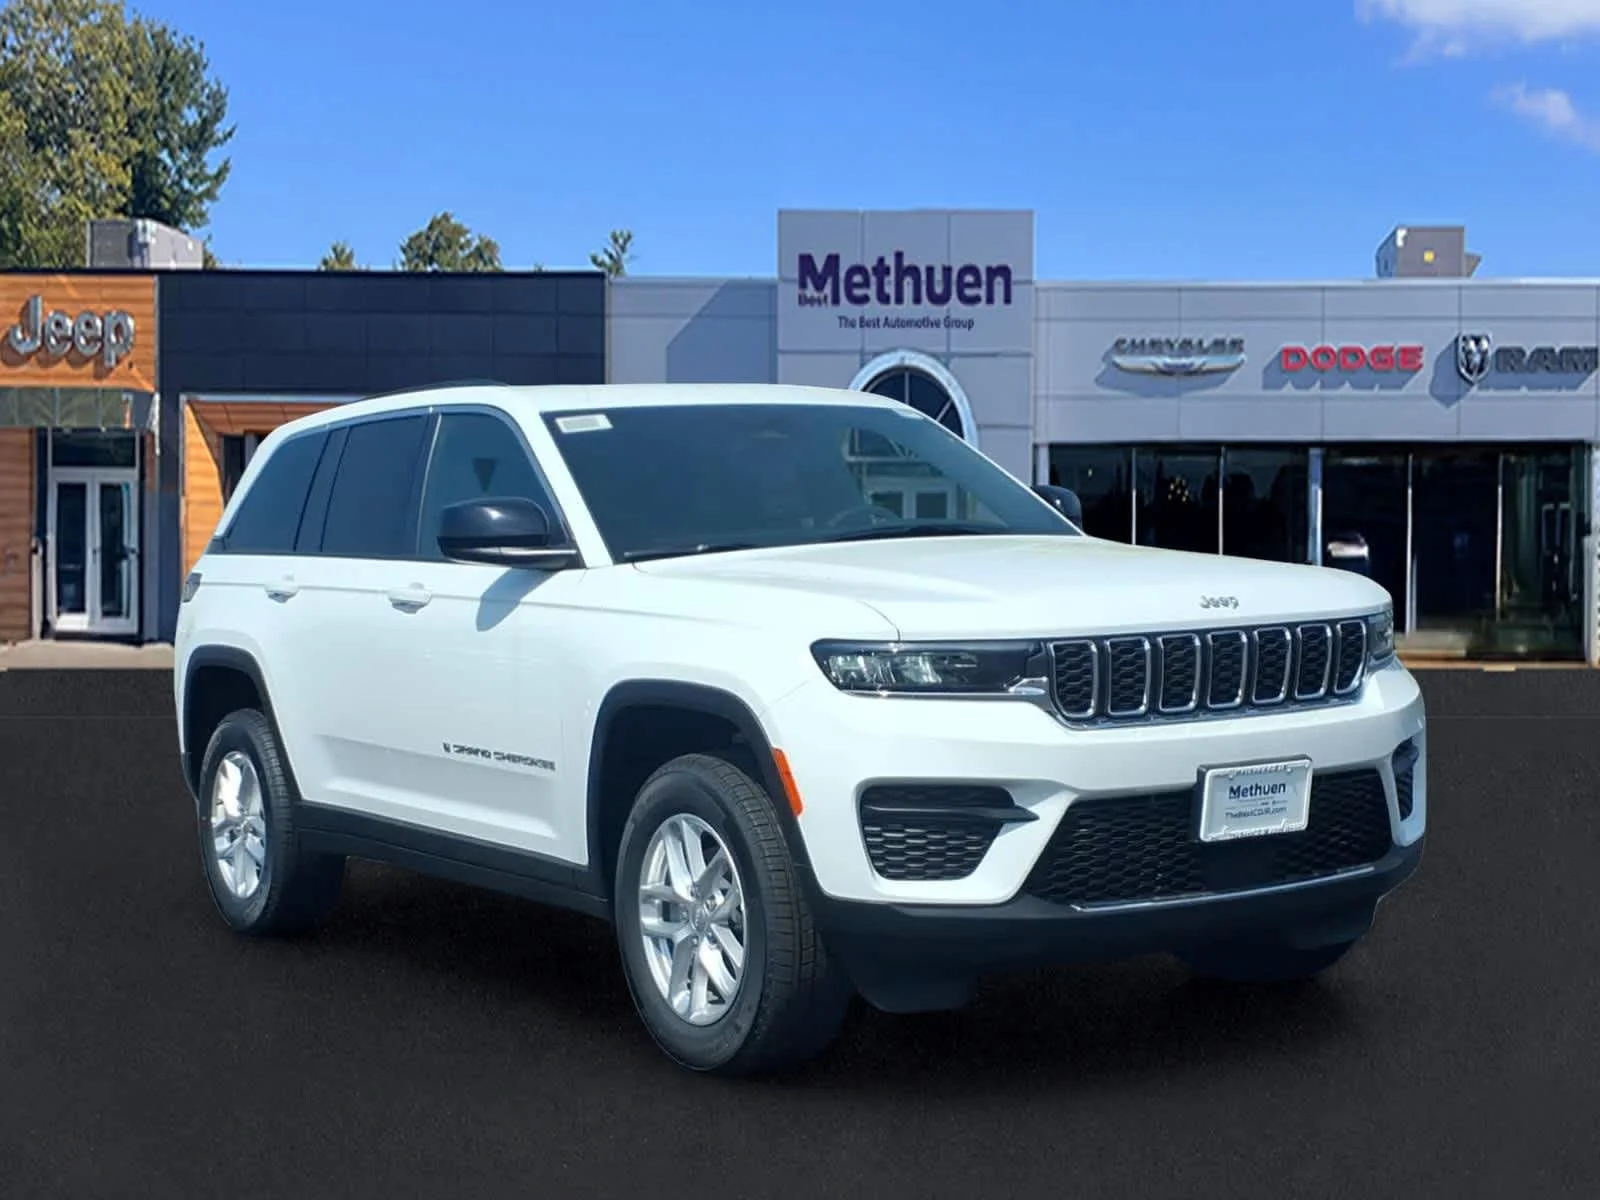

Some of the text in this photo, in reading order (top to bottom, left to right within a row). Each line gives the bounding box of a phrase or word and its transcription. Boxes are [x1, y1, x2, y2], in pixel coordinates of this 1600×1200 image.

[798, 251, 1012, 306] Methuen
[798, 292, 829, 307] Best
[9, 295, 135, 368] Jeep
[838, 315, 974, 330] The Best Automotive Group
[1114, 336, 1245, 354] CHRYSLER
[1281, 346, 1424, 371] DODGE
[1495, 346, 1599, 373] RAM
[1200, 595, 1239, 610] Jeep
[452, 744, 556, 771] GRAND CHEROKEE
[1228, 782, 1286, 800] Methuen
